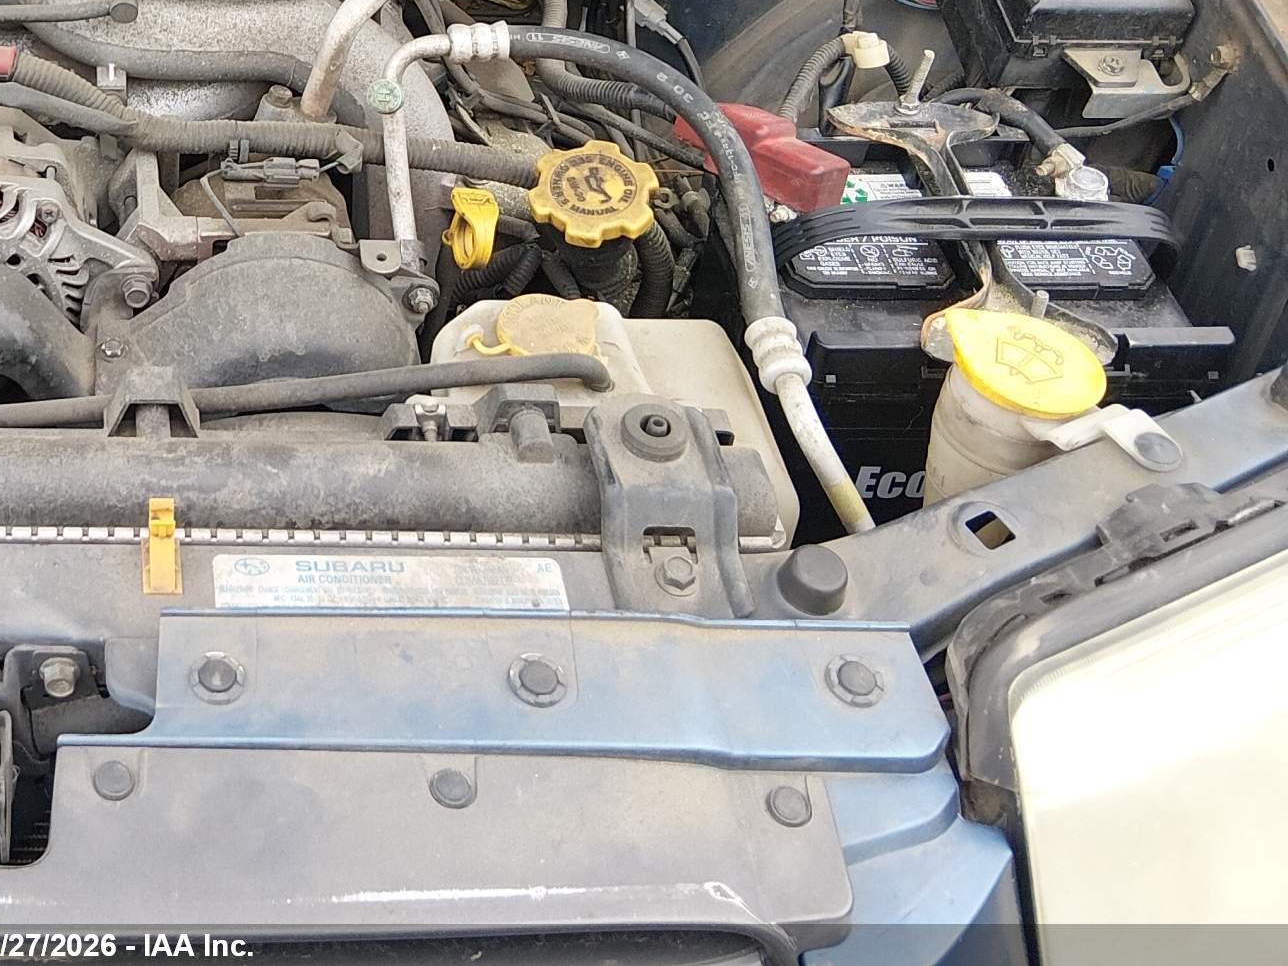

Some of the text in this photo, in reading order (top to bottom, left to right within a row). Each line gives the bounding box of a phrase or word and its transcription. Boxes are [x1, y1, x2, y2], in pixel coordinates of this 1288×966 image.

[598, 155, 635, 204] ENGINE OIL
[569, 204, 620, 216] MANUAL
[295, 559, 553, 574] SUBARU AE
[297, 574, 392, 584] AIR CONDITIONER
